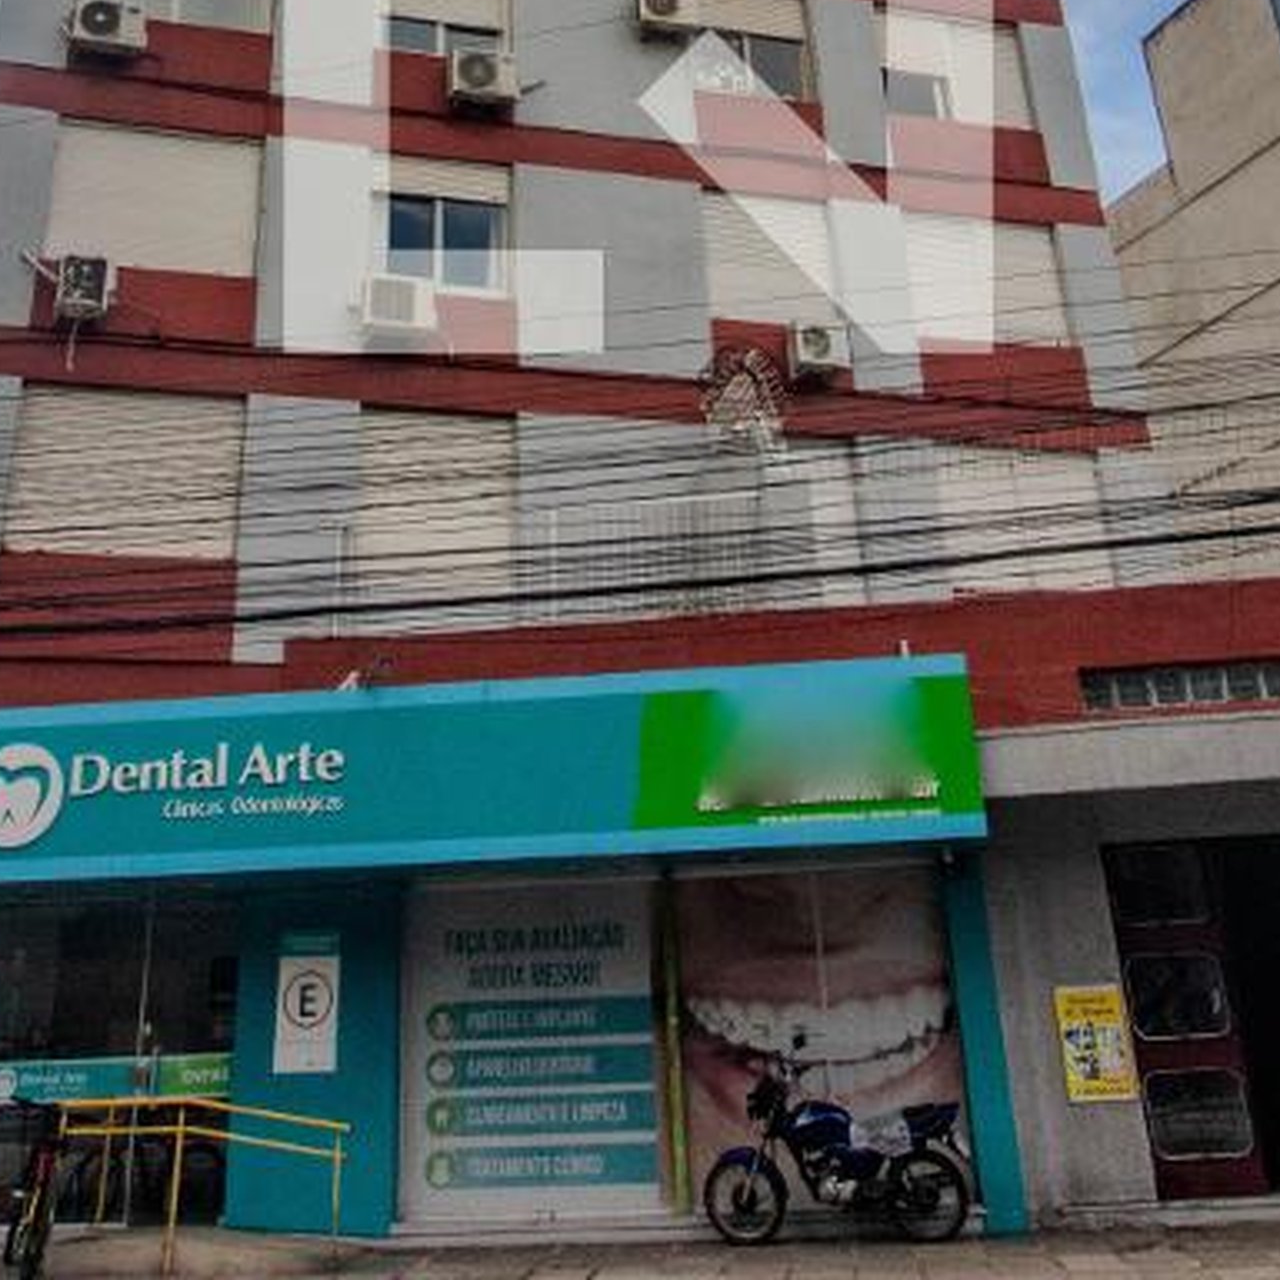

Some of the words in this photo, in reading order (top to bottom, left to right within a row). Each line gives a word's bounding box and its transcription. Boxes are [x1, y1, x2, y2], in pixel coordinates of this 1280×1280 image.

[69, 742, 230, 797] Dental
[236, 742, 346, 786] Arte
[299, 983, 317, 1017] E
